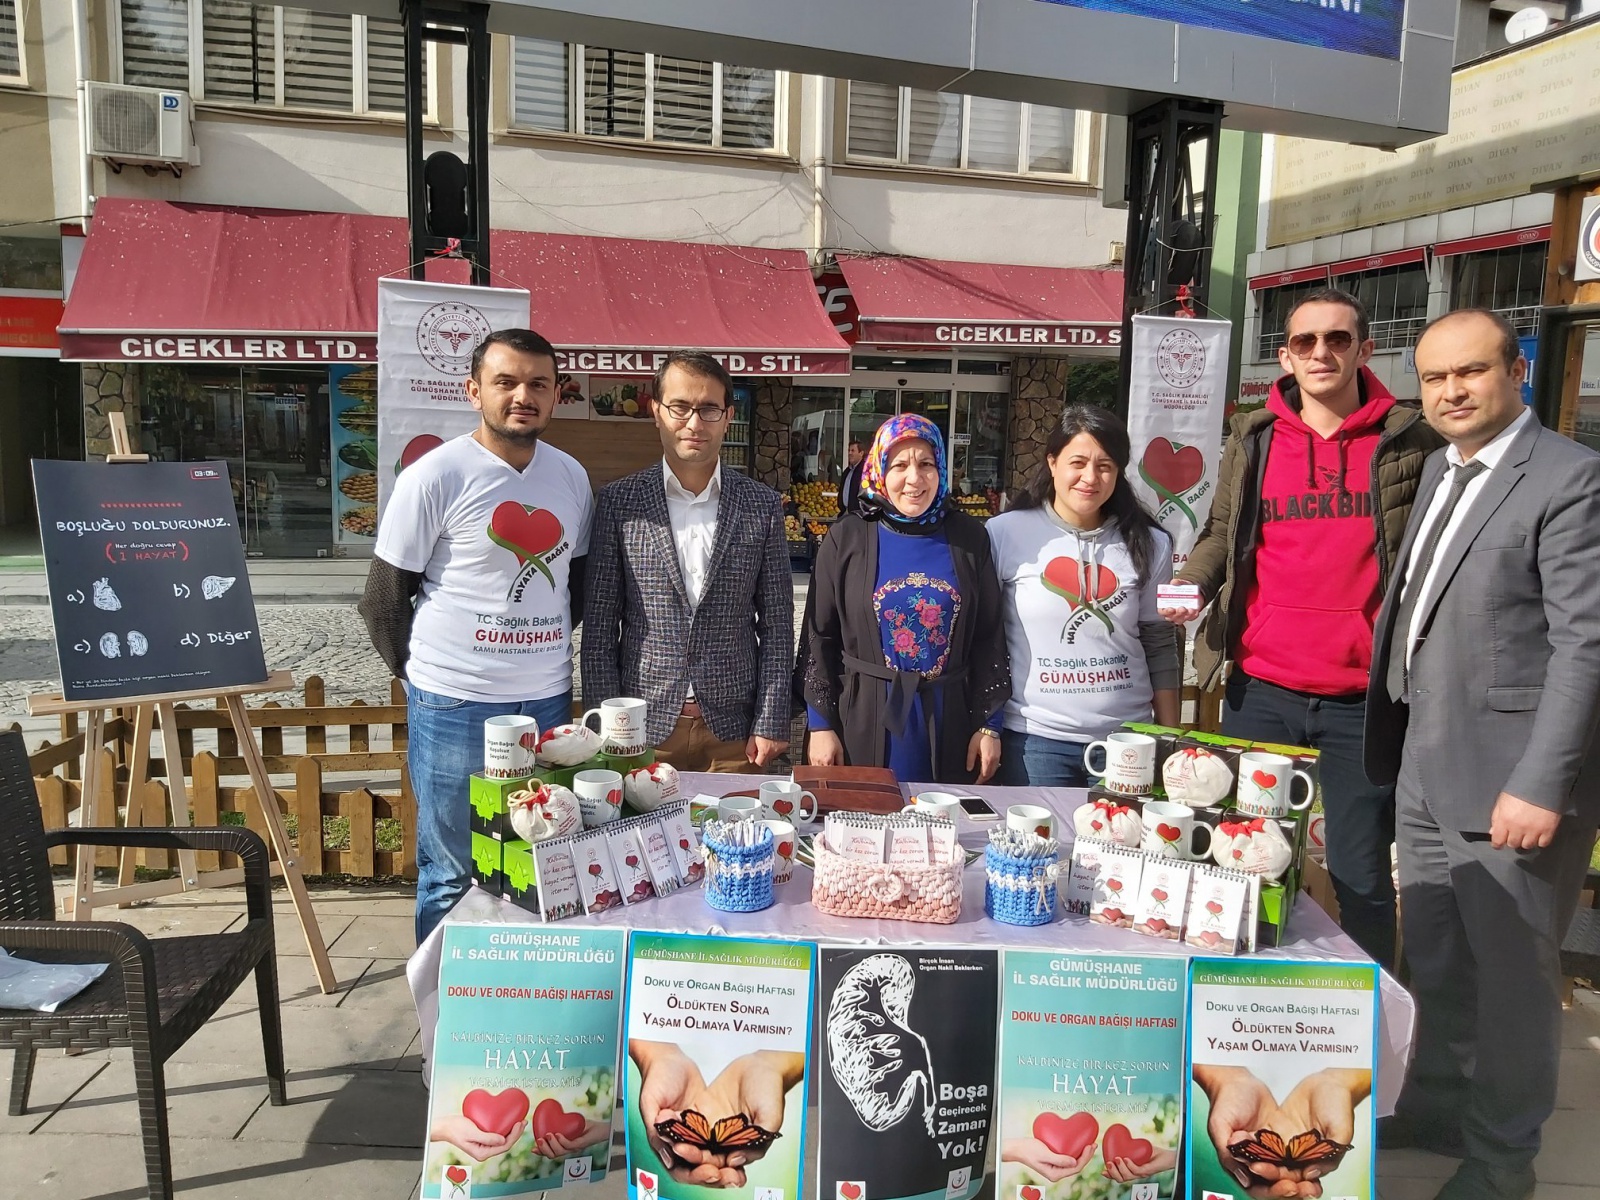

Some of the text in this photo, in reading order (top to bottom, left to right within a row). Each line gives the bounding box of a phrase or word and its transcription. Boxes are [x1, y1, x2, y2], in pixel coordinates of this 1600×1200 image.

[1054, 328, 1102, 344] LTD.
[296, 340, 366, 359] LTD.
[714, 354, 752, 372] TD.
[410, 386, 460, 394] GÜMÜŞHANE
[428, 380, 456, 388] SAĞLIK
[430, 394, 472, 402] MÜDÜRLÜ
[1187, 480, 1210, 505] BAĞIŞ
[56, 517, 231, 536] BOŞLUĞU DOLDURUNUZ.
[130, 541, 154, 550] doğru
[514, 541, 570, 603] HAYATA BAĞIŞ
[66, 589, 85, 604] a)
[174, 584, 190, 598] b)
[476, 614, 494, 625] T.C.
[496, 616, 530, 629] Sağlık
[1066, 612, 1092, 645] HAYATA
[1102, 590, 1128, 612] BAĞIŞ
[207, 630, 252, 646] Diğer
[475, 628, 564, 646] GÜMÜŞHANE
[74, 639, 91, 654] c)
[473, 646, 496, 654] KAMU
[1037, 658, 1053, 668] T.C.
[1054, 658, 1088, 670] Sağlık
[1040, 668, 1131, 686] GÜMÜŞHANE
[1062, 686, 1112, 694] HASTANELERİ
[489, 932, 581, 948] GÜMÜŞHANE
[452, 946, 615, 964] İL SAĞLIK MÜDÜRLÜĞÜ
[640, 948, 697, 960] GÜMÜŞHANE
[708, 952, 743, 964] SAĞLIK
[746, 954, 802, 968] MÜDÜRLÜĞÜ
[1050, 958, 1142, 975] GÜMÜŞHANE
[644, 976, 795, 996] DOKU VE ORGAN BAĞIŞI HAFTASI
[1013, 970, 1178, 992] İL SAĞLIK MÜDÜRLÜĞÜ
[1200, 973, 1258, 985] GÜMÜŞHANE
[1270, 974, 1305, 986] SAĞLIK
[1307, 976, 1366, 988] MÜDÜRLÜĞÜ
[448, 985, 614, 1002] DOKU VE ORGAN BAĞIŞI HAFTASI
[666, 993, 770, 1016] ÖLDÜKTEN SONRA
[1206, 1001, 1360, 1016] DOKU VE ORGAN BAĞIŞI HAFTASI
[642, 1012, 792, 1036] YAŞAM OLMAYA VARMISIN?
[1012, 1010, 1177, 1029] DOKU VE ORGAN BAĞIŞI HAFTASI
[1232, 1018, 1335, 1035] ÖLDÜKTEN SONRA
[538, 1034, 561, 1044] KEZ
[564, 1034, 606, 1044] SORUN
[1207, 1038, 1360, 1054] YAŞAM OLMAYA VARMISIN?
[485, 1048, 570, 1070] HAYAT
[1106, 1060, 1126, 1070] KEZ
[1131, 1061, 1170, 1071] SORUN
[1053, 1072, 1137, 1096] HAYAT
[940, 1083, 988, 1103] Boşa
[938, 1104, 986, 1117] Geçirecek
[938, 1118, 986, 1135] Zaman
[938, 1136, 984, 1160] Yok!
